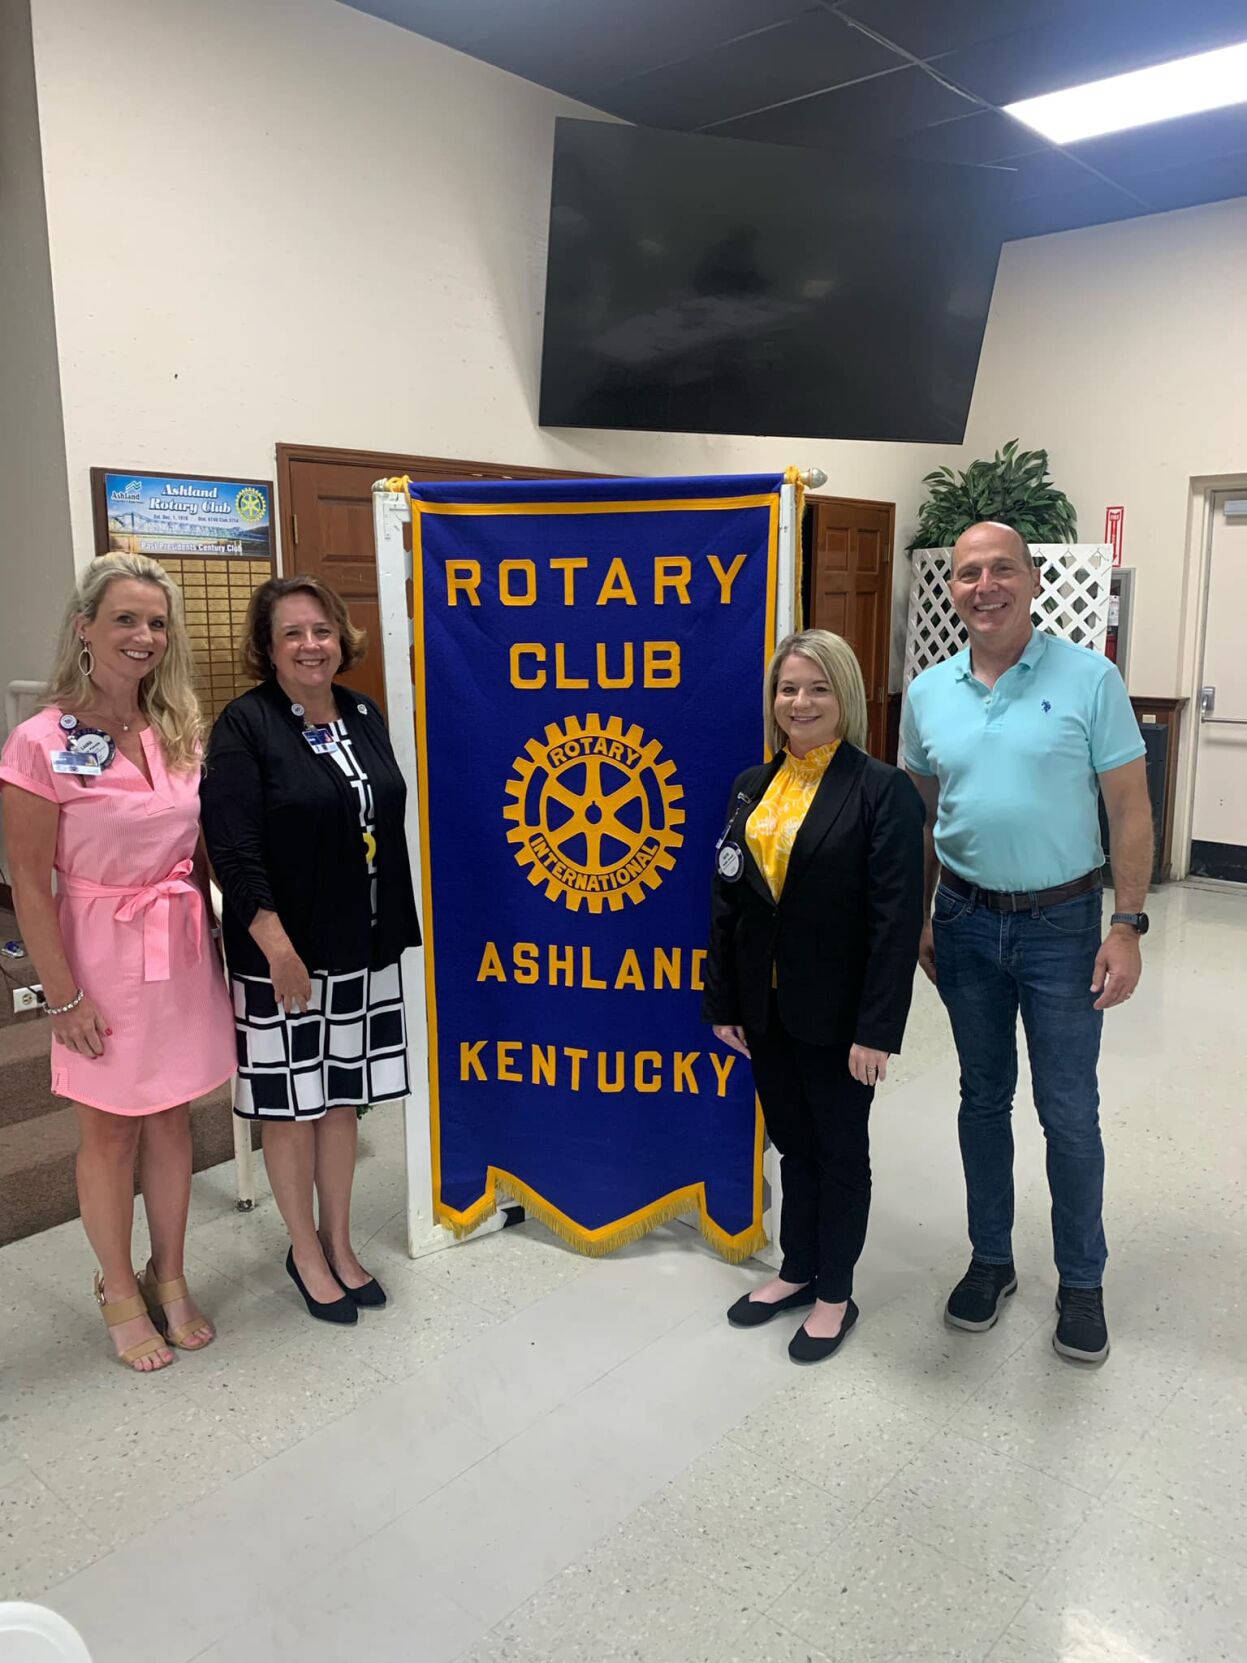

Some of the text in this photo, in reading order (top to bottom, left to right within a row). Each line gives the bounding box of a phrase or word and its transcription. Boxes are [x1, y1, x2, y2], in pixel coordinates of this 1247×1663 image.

[112, 490, 141, 501] Ashland
[162, 484, 218, 499] Ashland
[149, 498, 198, 515] Rotary
[202, 501, 232, 514] Club
[140, 541, 157, 551] Past
[159, 542, 197, 552] Presidents
[198, 543, 226, 553] Century
[446, 555, 746, 607] ROTARY
[509, 642, 681, 690] CLUB
[550, 737, 640, 766] ROTARY
[530, 833, 660, 891] INTERNATIONAL
[460, 1040, 735, 1097] KENTUCKY
